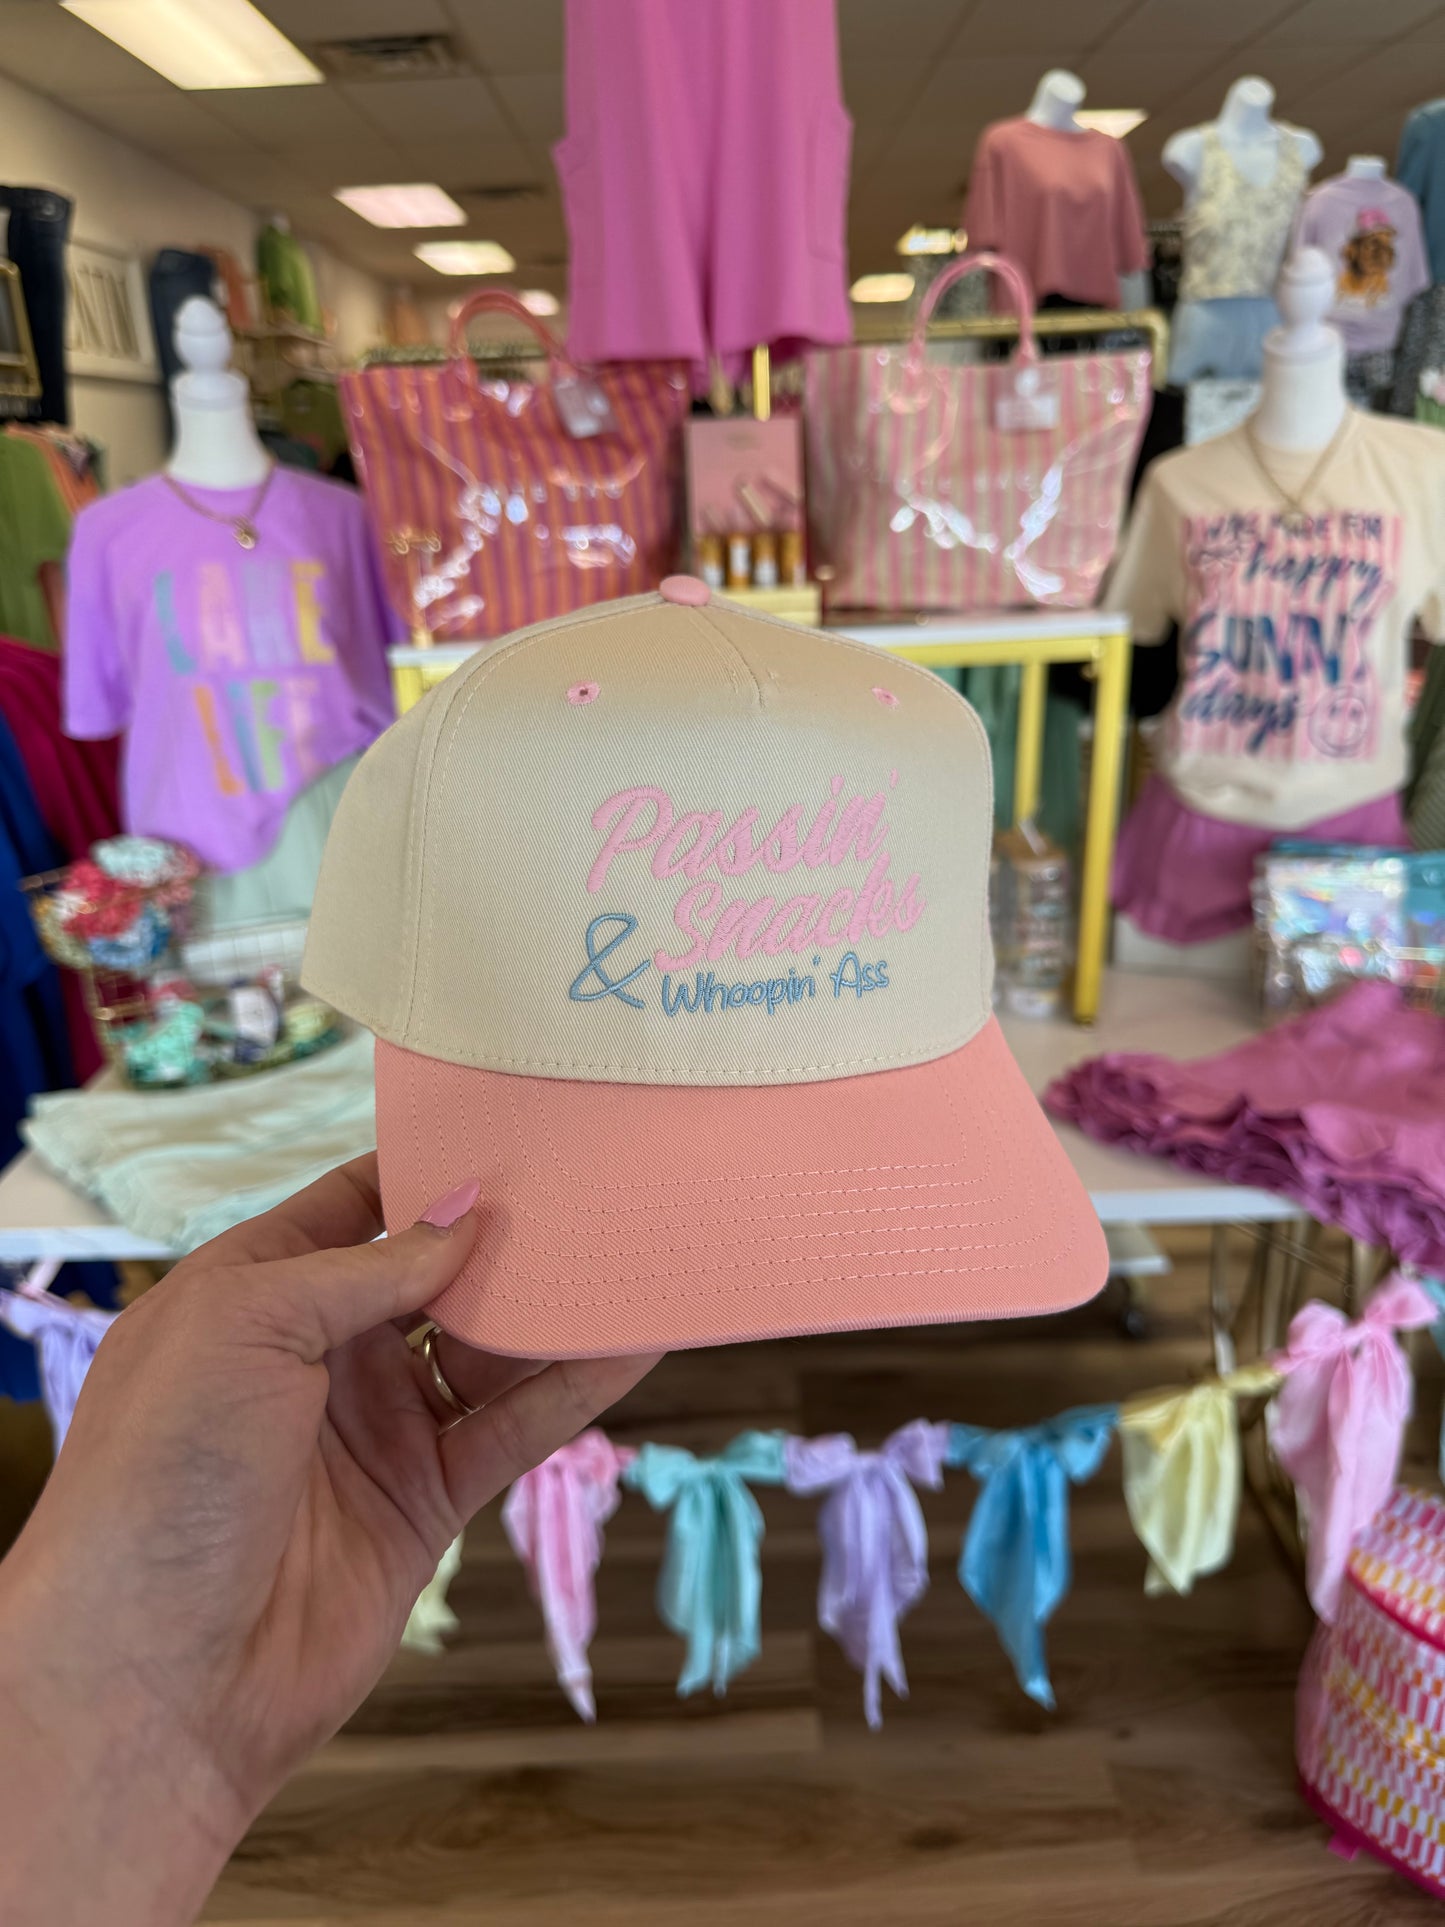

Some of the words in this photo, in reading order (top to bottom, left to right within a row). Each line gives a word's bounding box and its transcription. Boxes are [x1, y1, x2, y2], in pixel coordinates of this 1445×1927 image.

[586, 768, 900, 894] Passin'
[568, 912, 651, 1010] &
[661, 954, 822, 1018] Whoopin'
[830, 951, 890, 1000] Ass
[653, 851, 926, 972] Snacks
